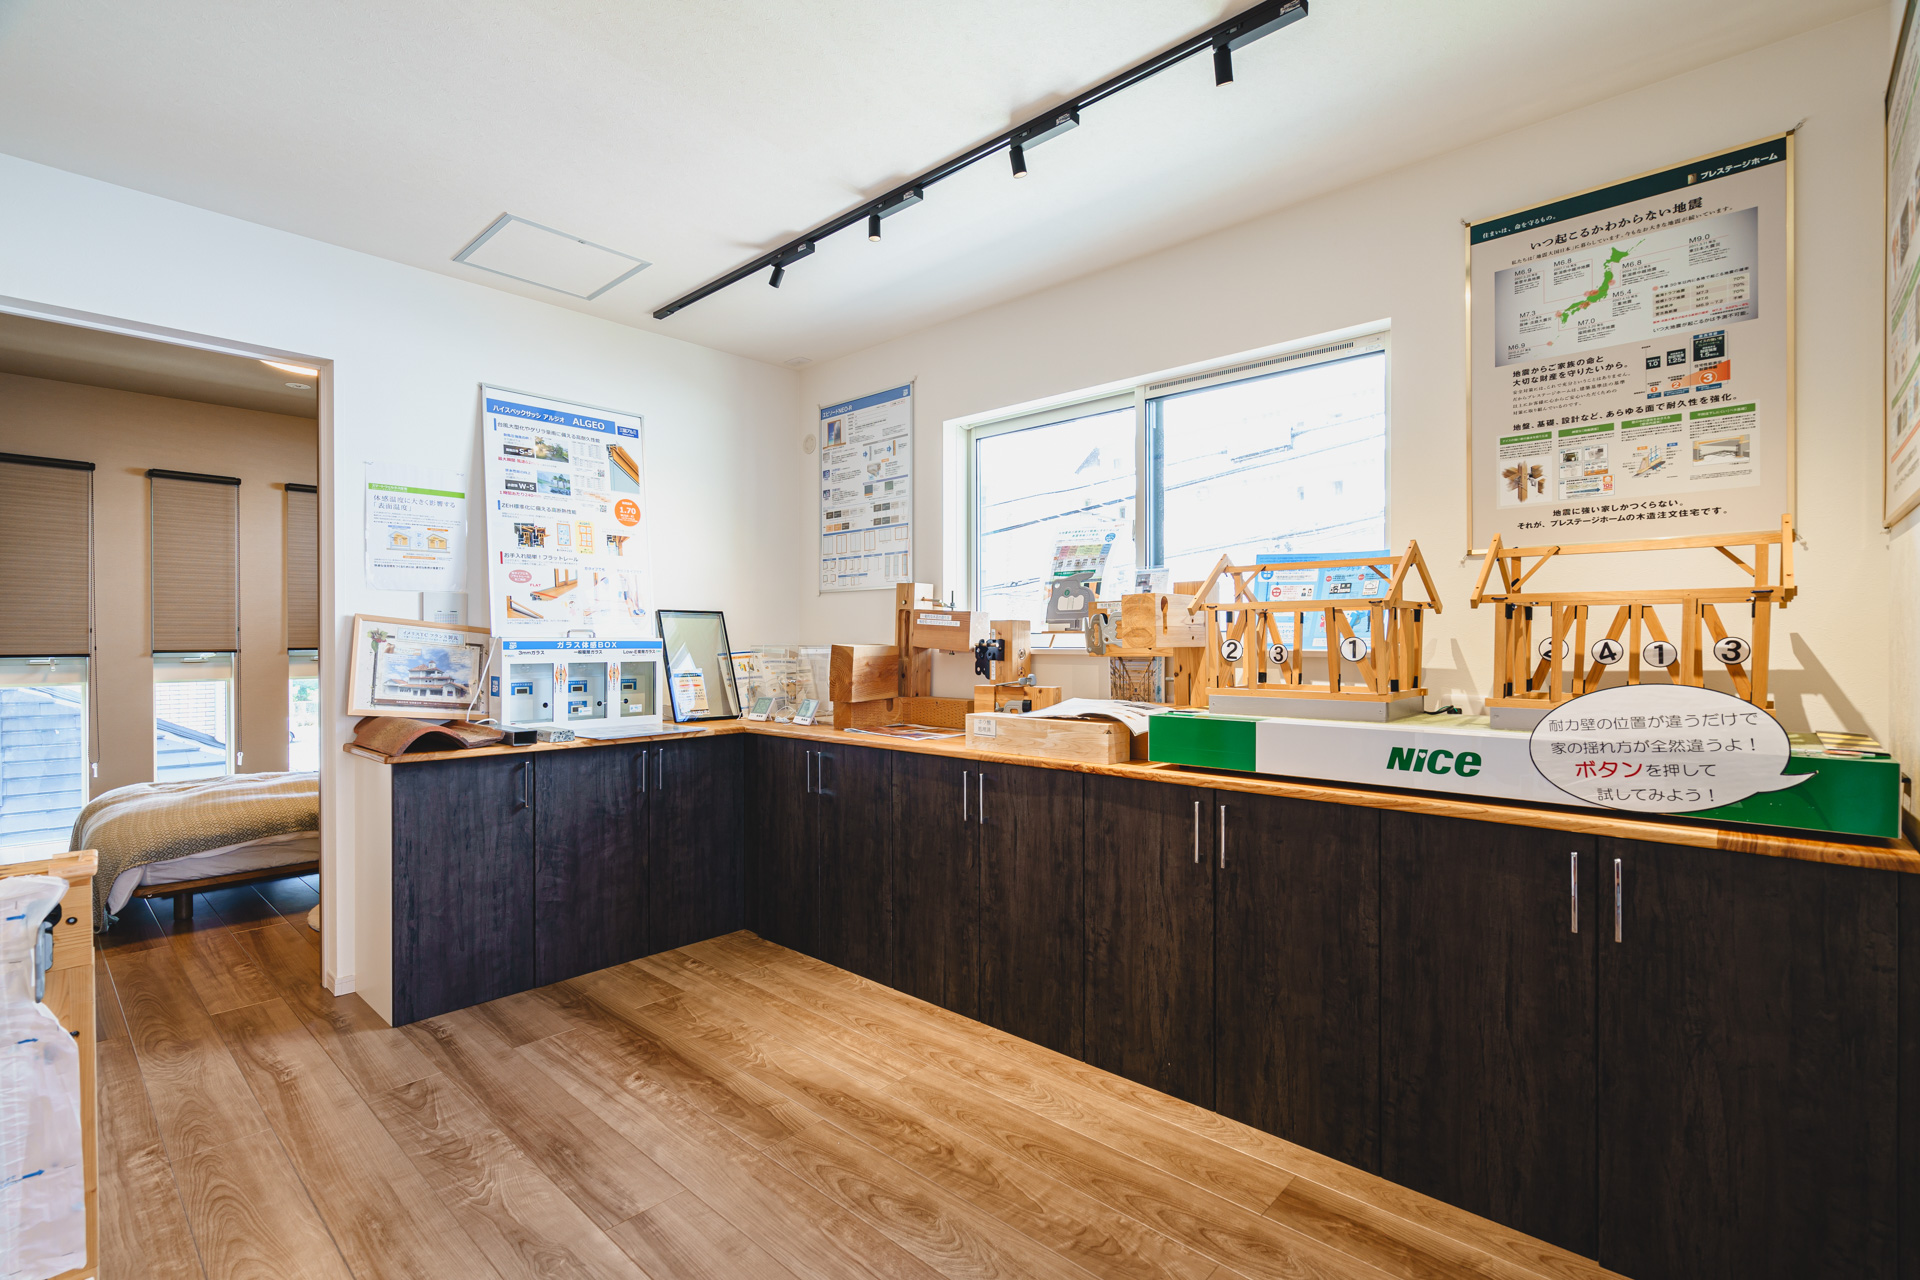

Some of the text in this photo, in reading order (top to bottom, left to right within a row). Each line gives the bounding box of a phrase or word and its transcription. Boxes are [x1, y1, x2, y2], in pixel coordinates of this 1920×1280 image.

[1701, 153, 1777, 179] プレステージホーム
[1530, 197, 1702, 250] いつ起こるかわからない地震
[1689, 234, 1710, 243] M9.0
[1554, 258, 1572, 267] M6.8
[1622, 260, 1642, 269] M6.8
[1514, 268, 1532, 277] M6.9
[1612, 289, 1632, 298] M5.4
[1577, 318, 1596, 326] M7.0
[1508, 343, 1526, 351] M6.9
[1512, 355, 1604, 378] 地震からご家族の命と
[1512, 361, 1628, 387] 大切な財産を守りたいから。
[1703, 373, 1713, 382] 3
[492, 405, 541, 419] ハイスペックサッシ
[572, 417, 605, 431] ALGEO
[1513, 393, 1737, 432] 地盤、基礎、設計など、あらゆる面で耐久性を強化。
[373, 494, 456, 509] 体感温度に大きく影響する
[373, 502, 412, 512] 「表面温度」
[619, 506, 637, 515] 1.70
[1552, 499, 1684, 517] 地震に強い家しかつくらない。
[1517, 506, 1728, 530] それが、プレステージホームの木造注文住宅です。
[556, 641, 618, 649] ガラス体感BOX
[1226, 641, 1238, 659] 2
[1273, 645, 1284, 662] 3
[1348, 640, 1357, 659] 1
[1599, 641, 1617, 660] 4
[1655, 644, 1665, 664] 1
[1721, 639, 1741, 663] 3
[1548, 711, 1758, 733] 耐力壁の位置が違うだけで
[1551, 737, 1756, 755] 家の揺れ方が全然違うよ！
[1575, 760, 1717, 779] ボタンを押して
[1597, 787, 1715, 803] 試してみよう！
